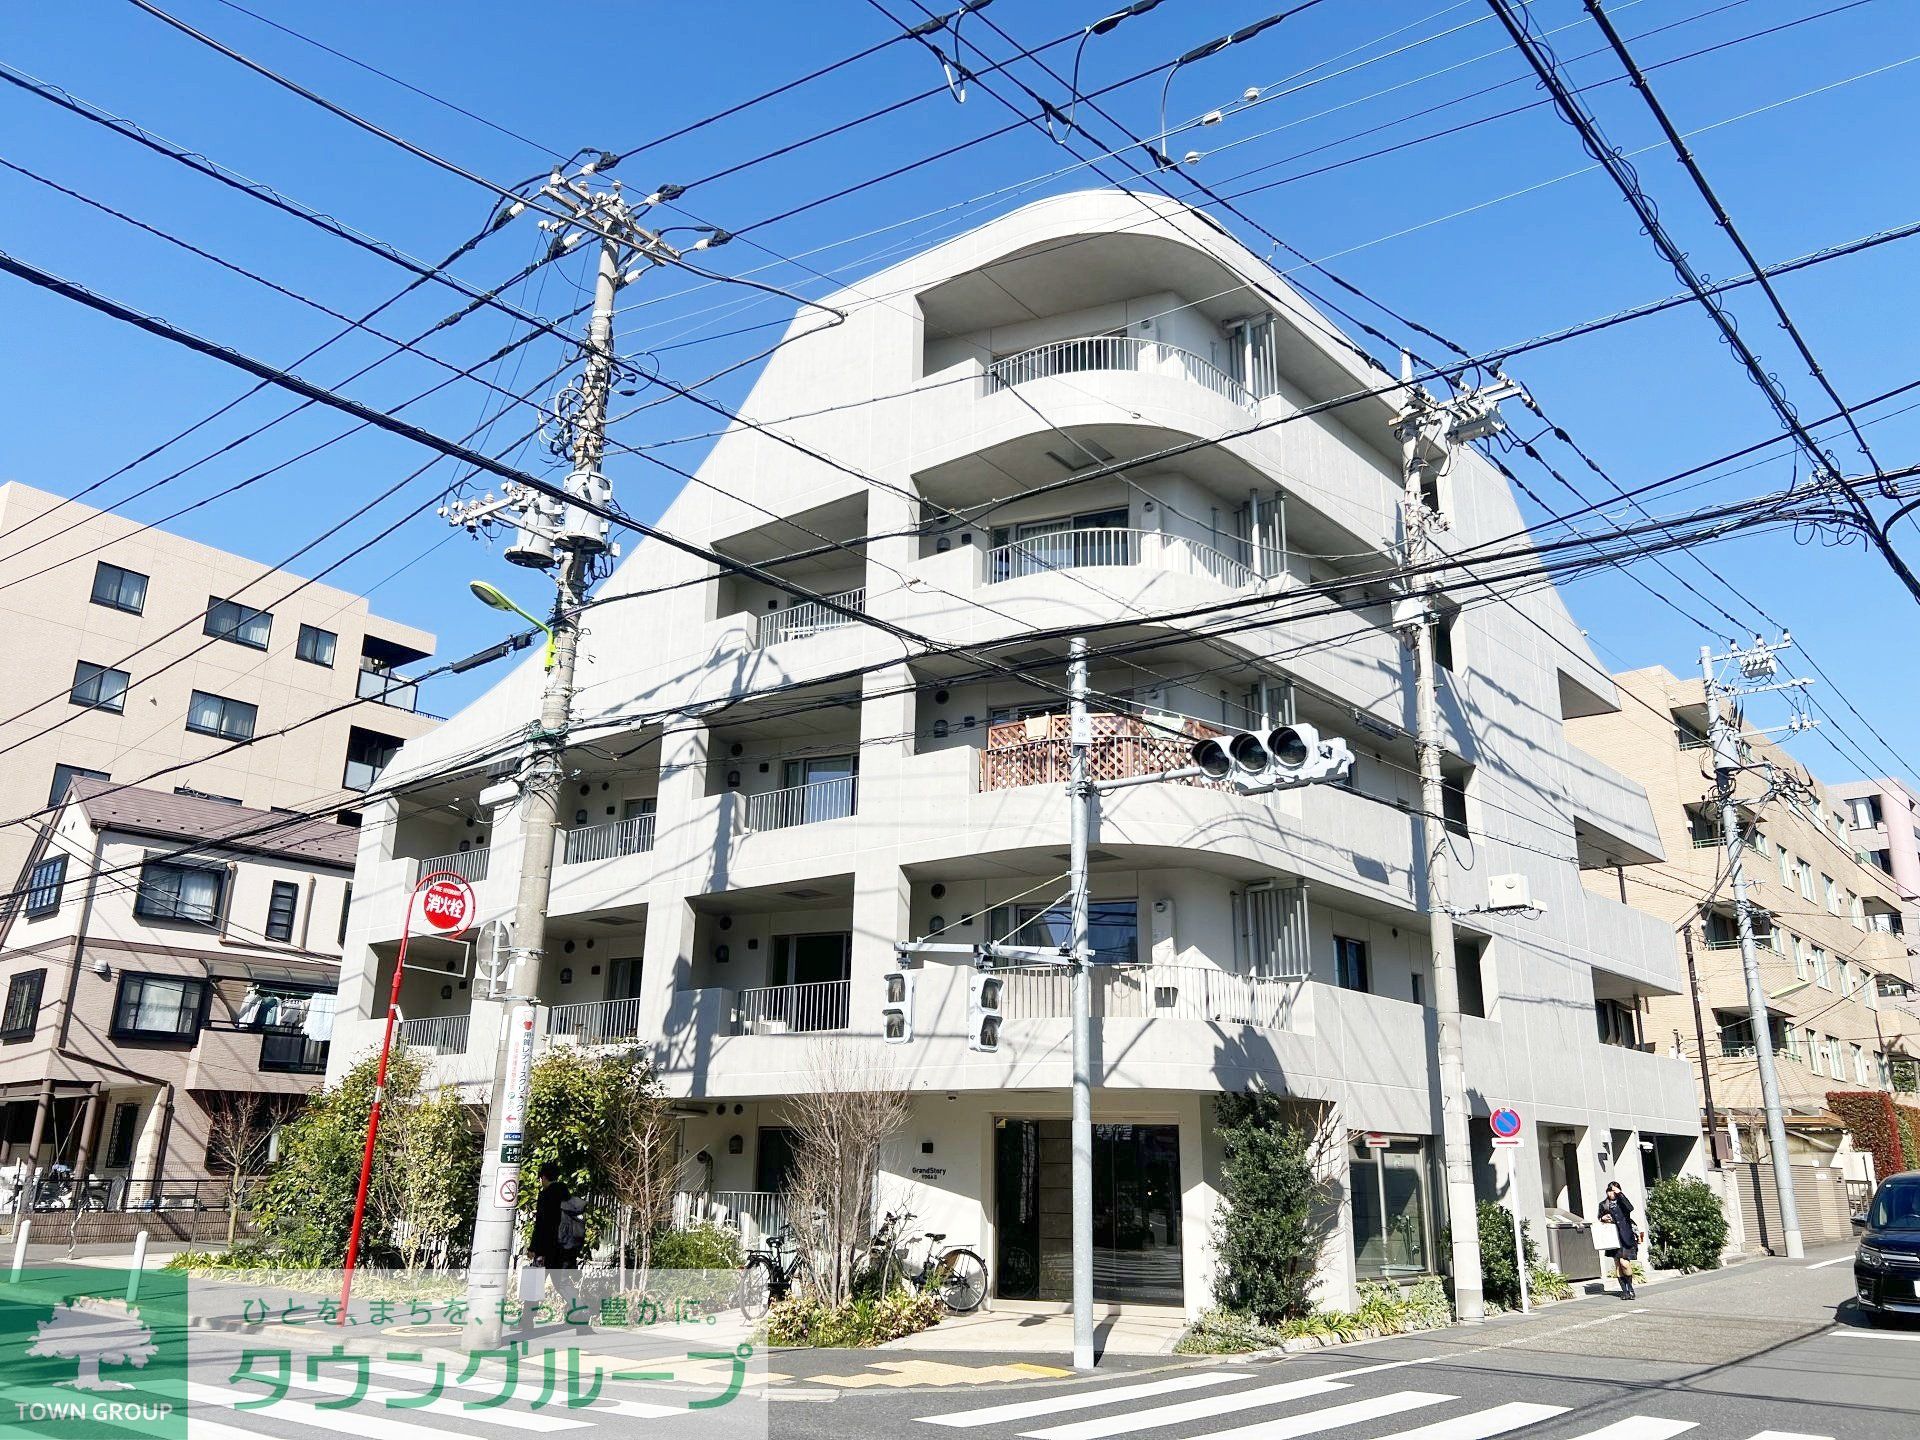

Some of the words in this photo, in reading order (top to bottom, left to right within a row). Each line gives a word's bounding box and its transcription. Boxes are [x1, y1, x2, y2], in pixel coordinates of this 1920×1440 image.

[426, 893, 464, 918] 消火栓
[912, 1167, 946, 1175] GrandStory
